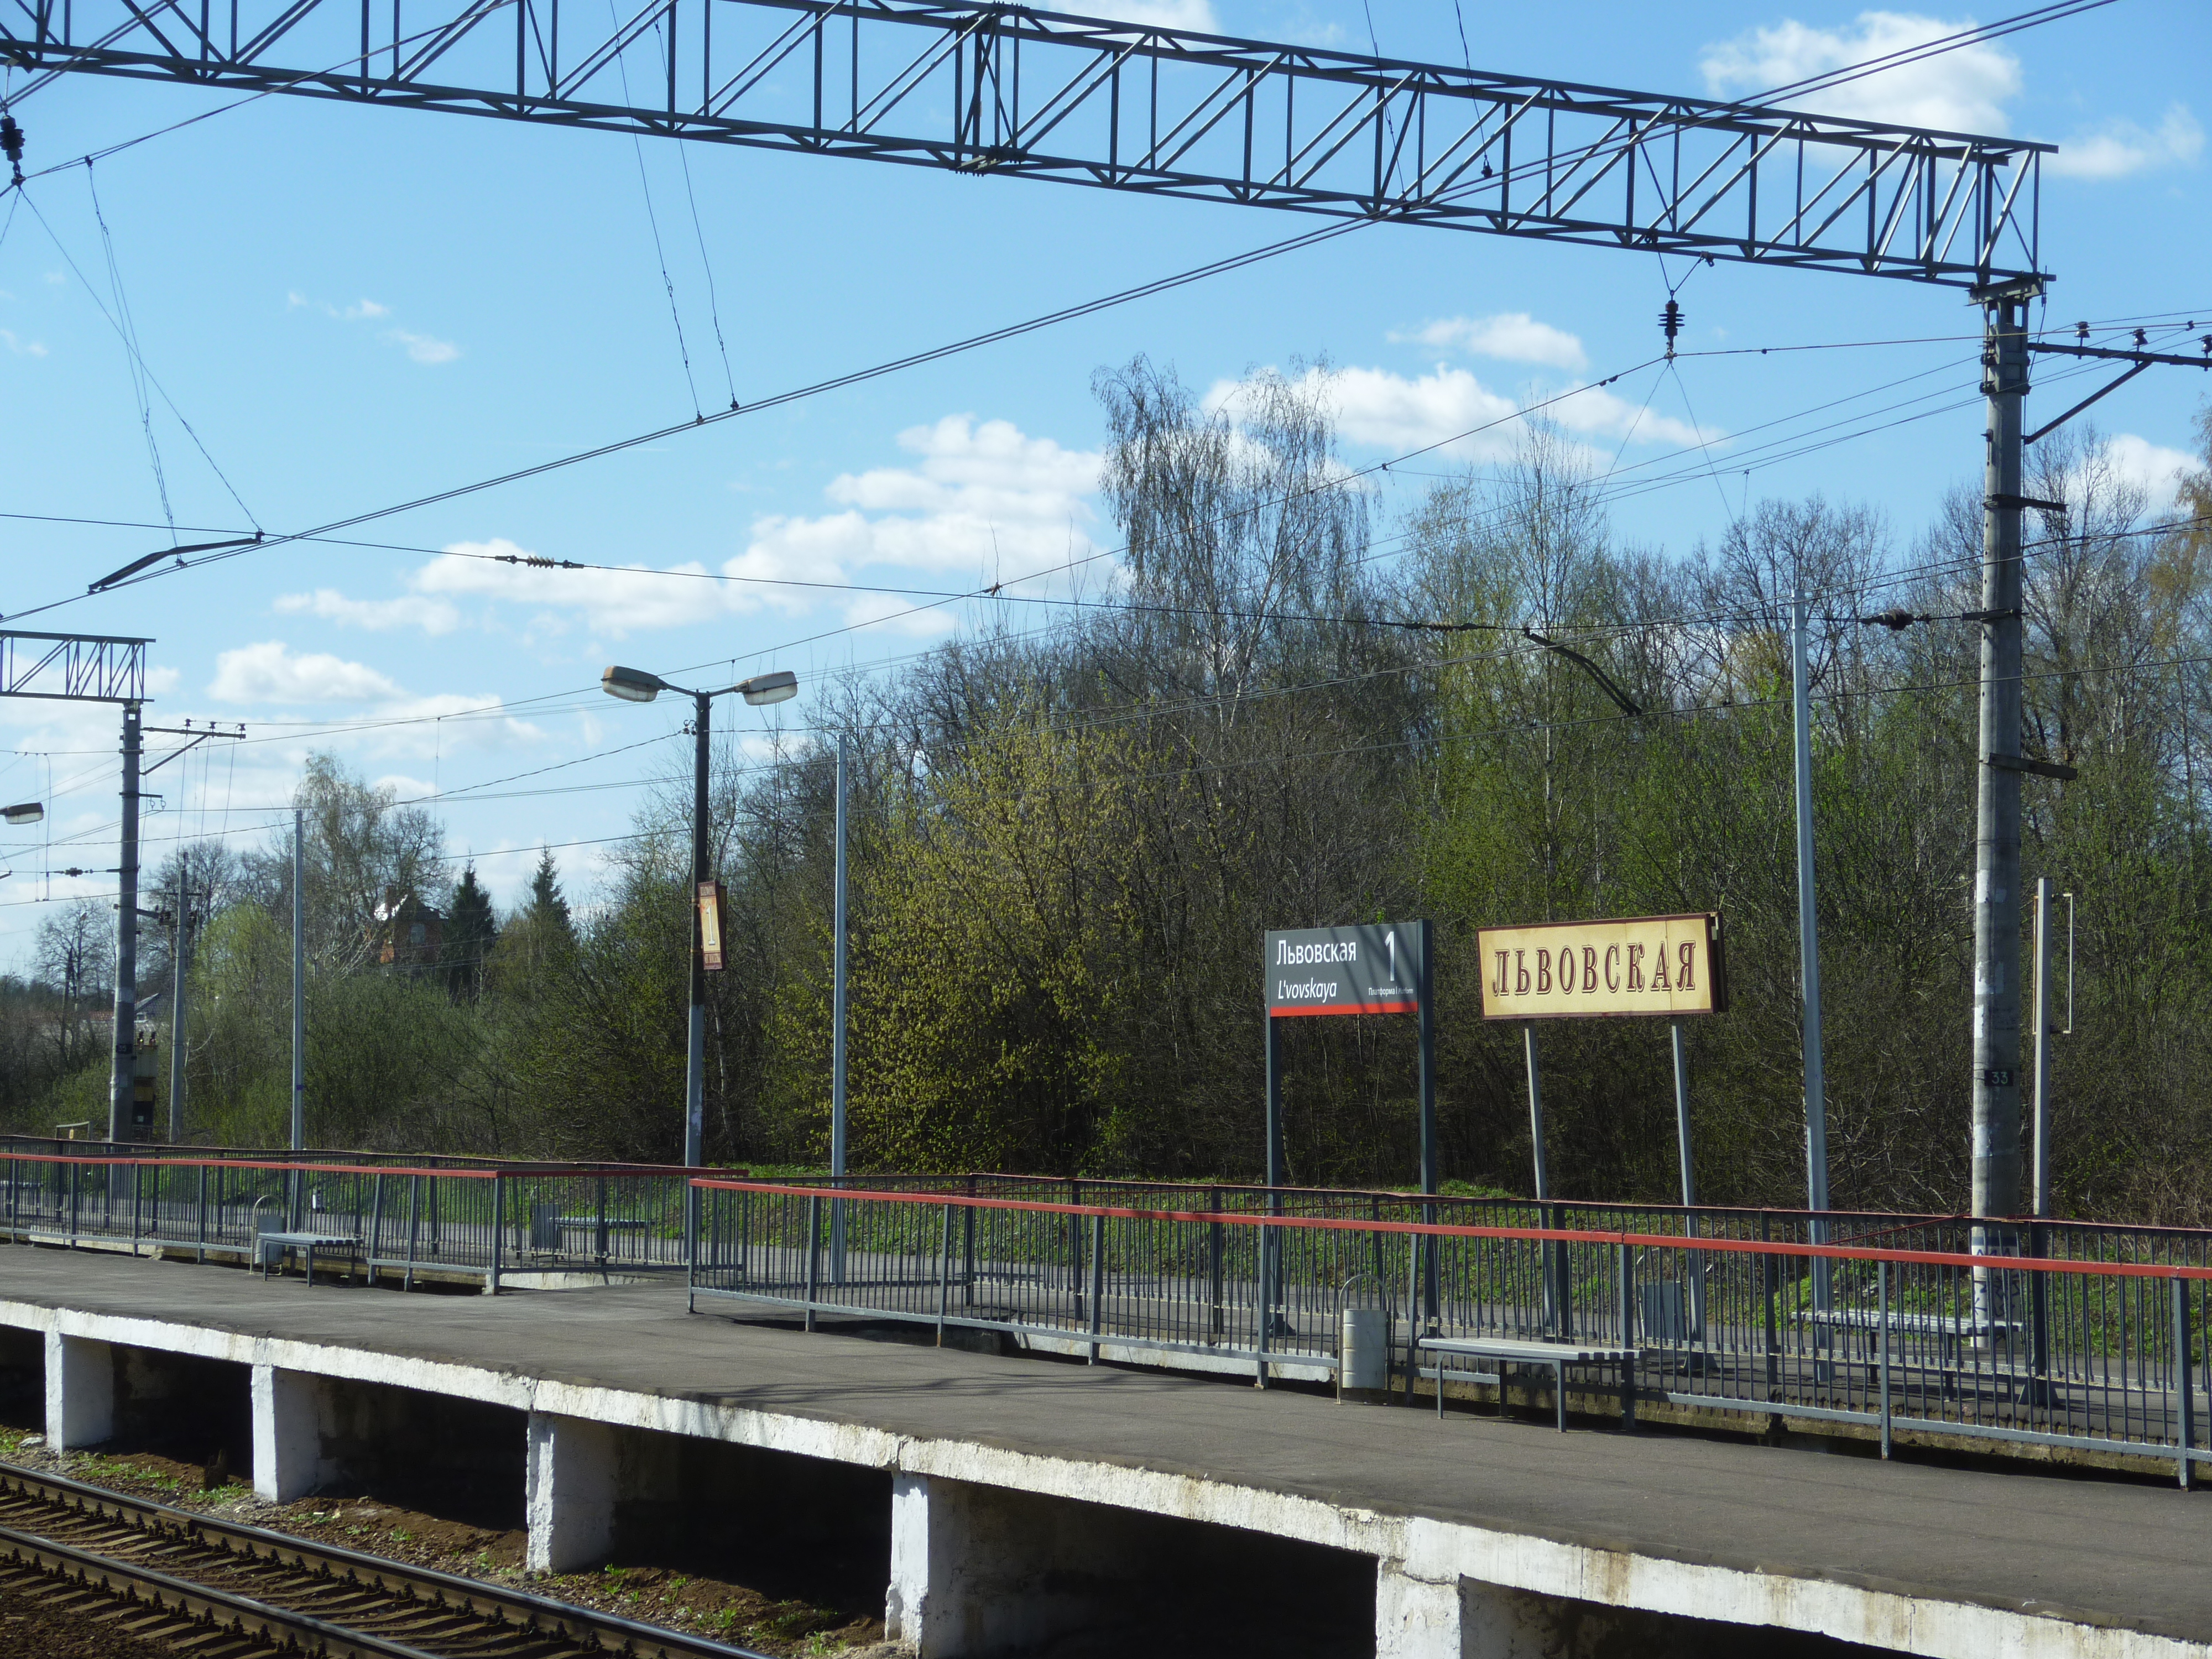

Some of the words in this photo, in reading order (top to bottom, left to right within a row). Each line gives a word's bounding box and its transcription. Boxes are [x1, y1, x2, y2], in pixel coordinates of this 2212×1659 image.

[706, 903, 716, 945] 1
[1276, 940, 1357, 965] Львовская
[1385, 931, 1395, 981] 1
[1493, 940, 1696, 997] ЛЬВОВСКАЯ
[1278, 977, 1338, 1003] L'vovskaya
[1368, 987, 1395, 997] Платформа
[1991, 1071, 2008, 1084] 33
